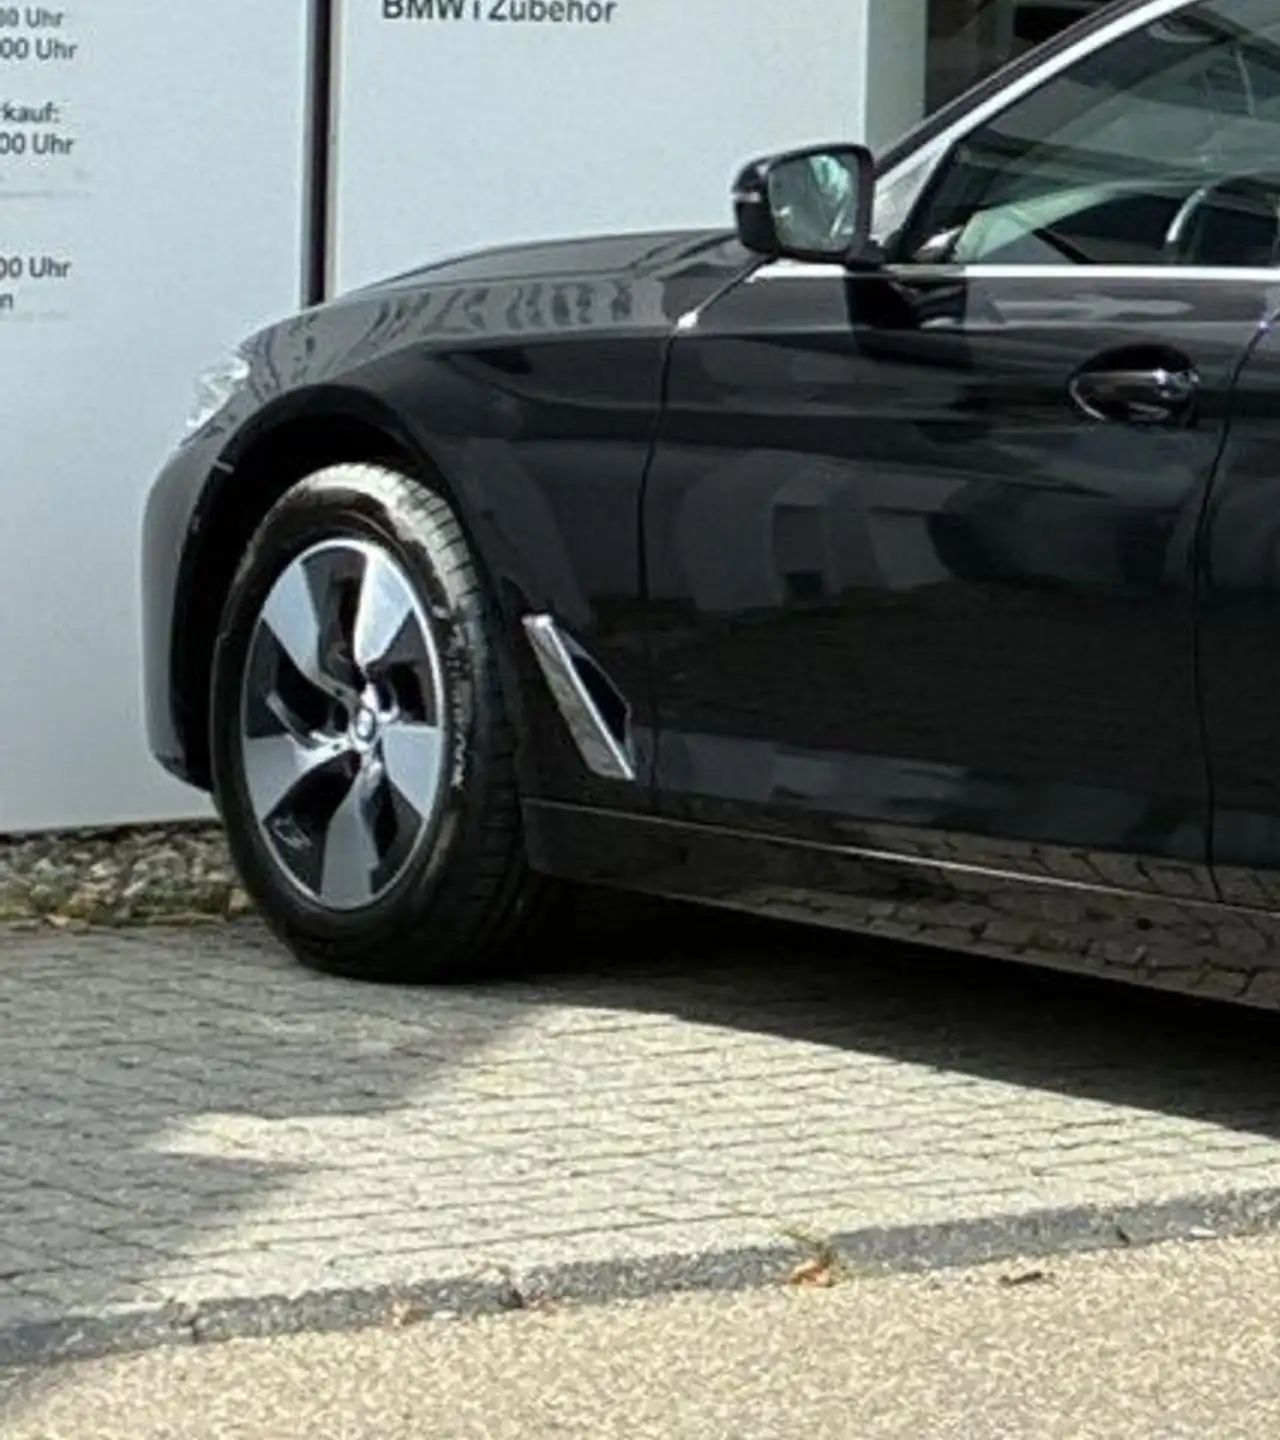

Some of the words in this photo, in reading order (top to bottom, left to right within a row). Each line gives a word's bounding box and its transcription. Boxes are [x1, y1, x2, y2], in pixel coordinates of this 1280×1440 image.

[26, 7, 65, 29] Uhr
[36, 38, 79, 60] Uhr
[33, 132, 75, 155] Uhr
[29, 256, 72, 279] Uhr
